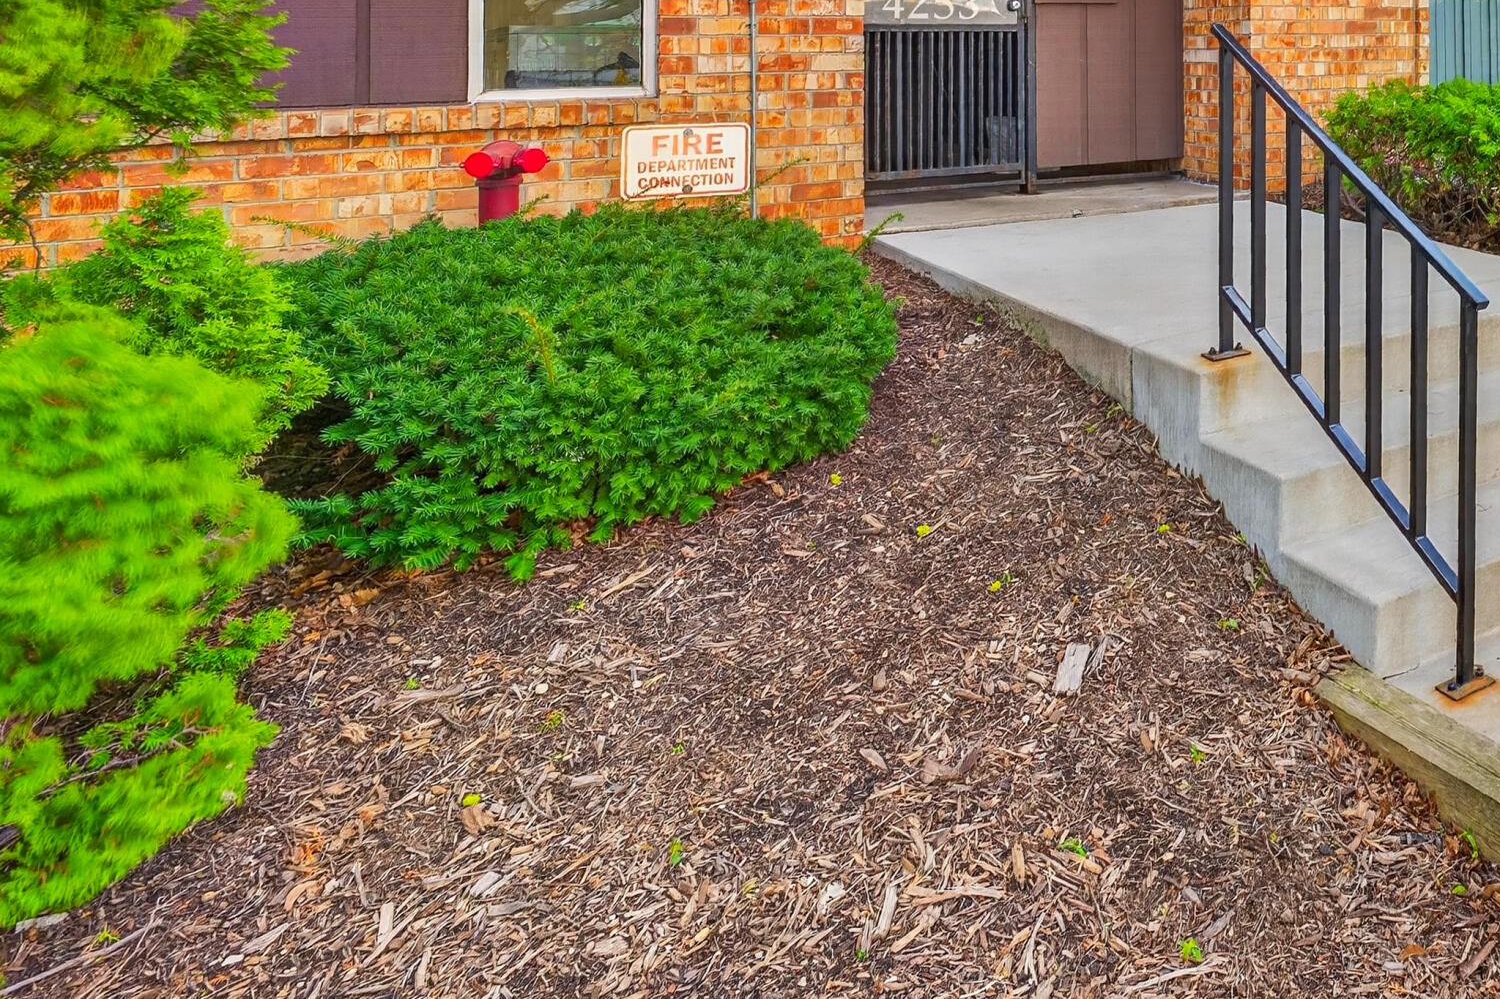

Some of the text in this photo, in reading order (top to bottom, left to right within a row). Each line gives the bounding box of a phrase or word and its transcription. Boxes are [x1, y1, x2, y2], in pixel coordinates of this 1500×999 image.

[652, 133, 723, 156] FIRE
[637, 157, 735, 174] DEPARTMENT
[638, 173, 734, 189] CONNECTION
